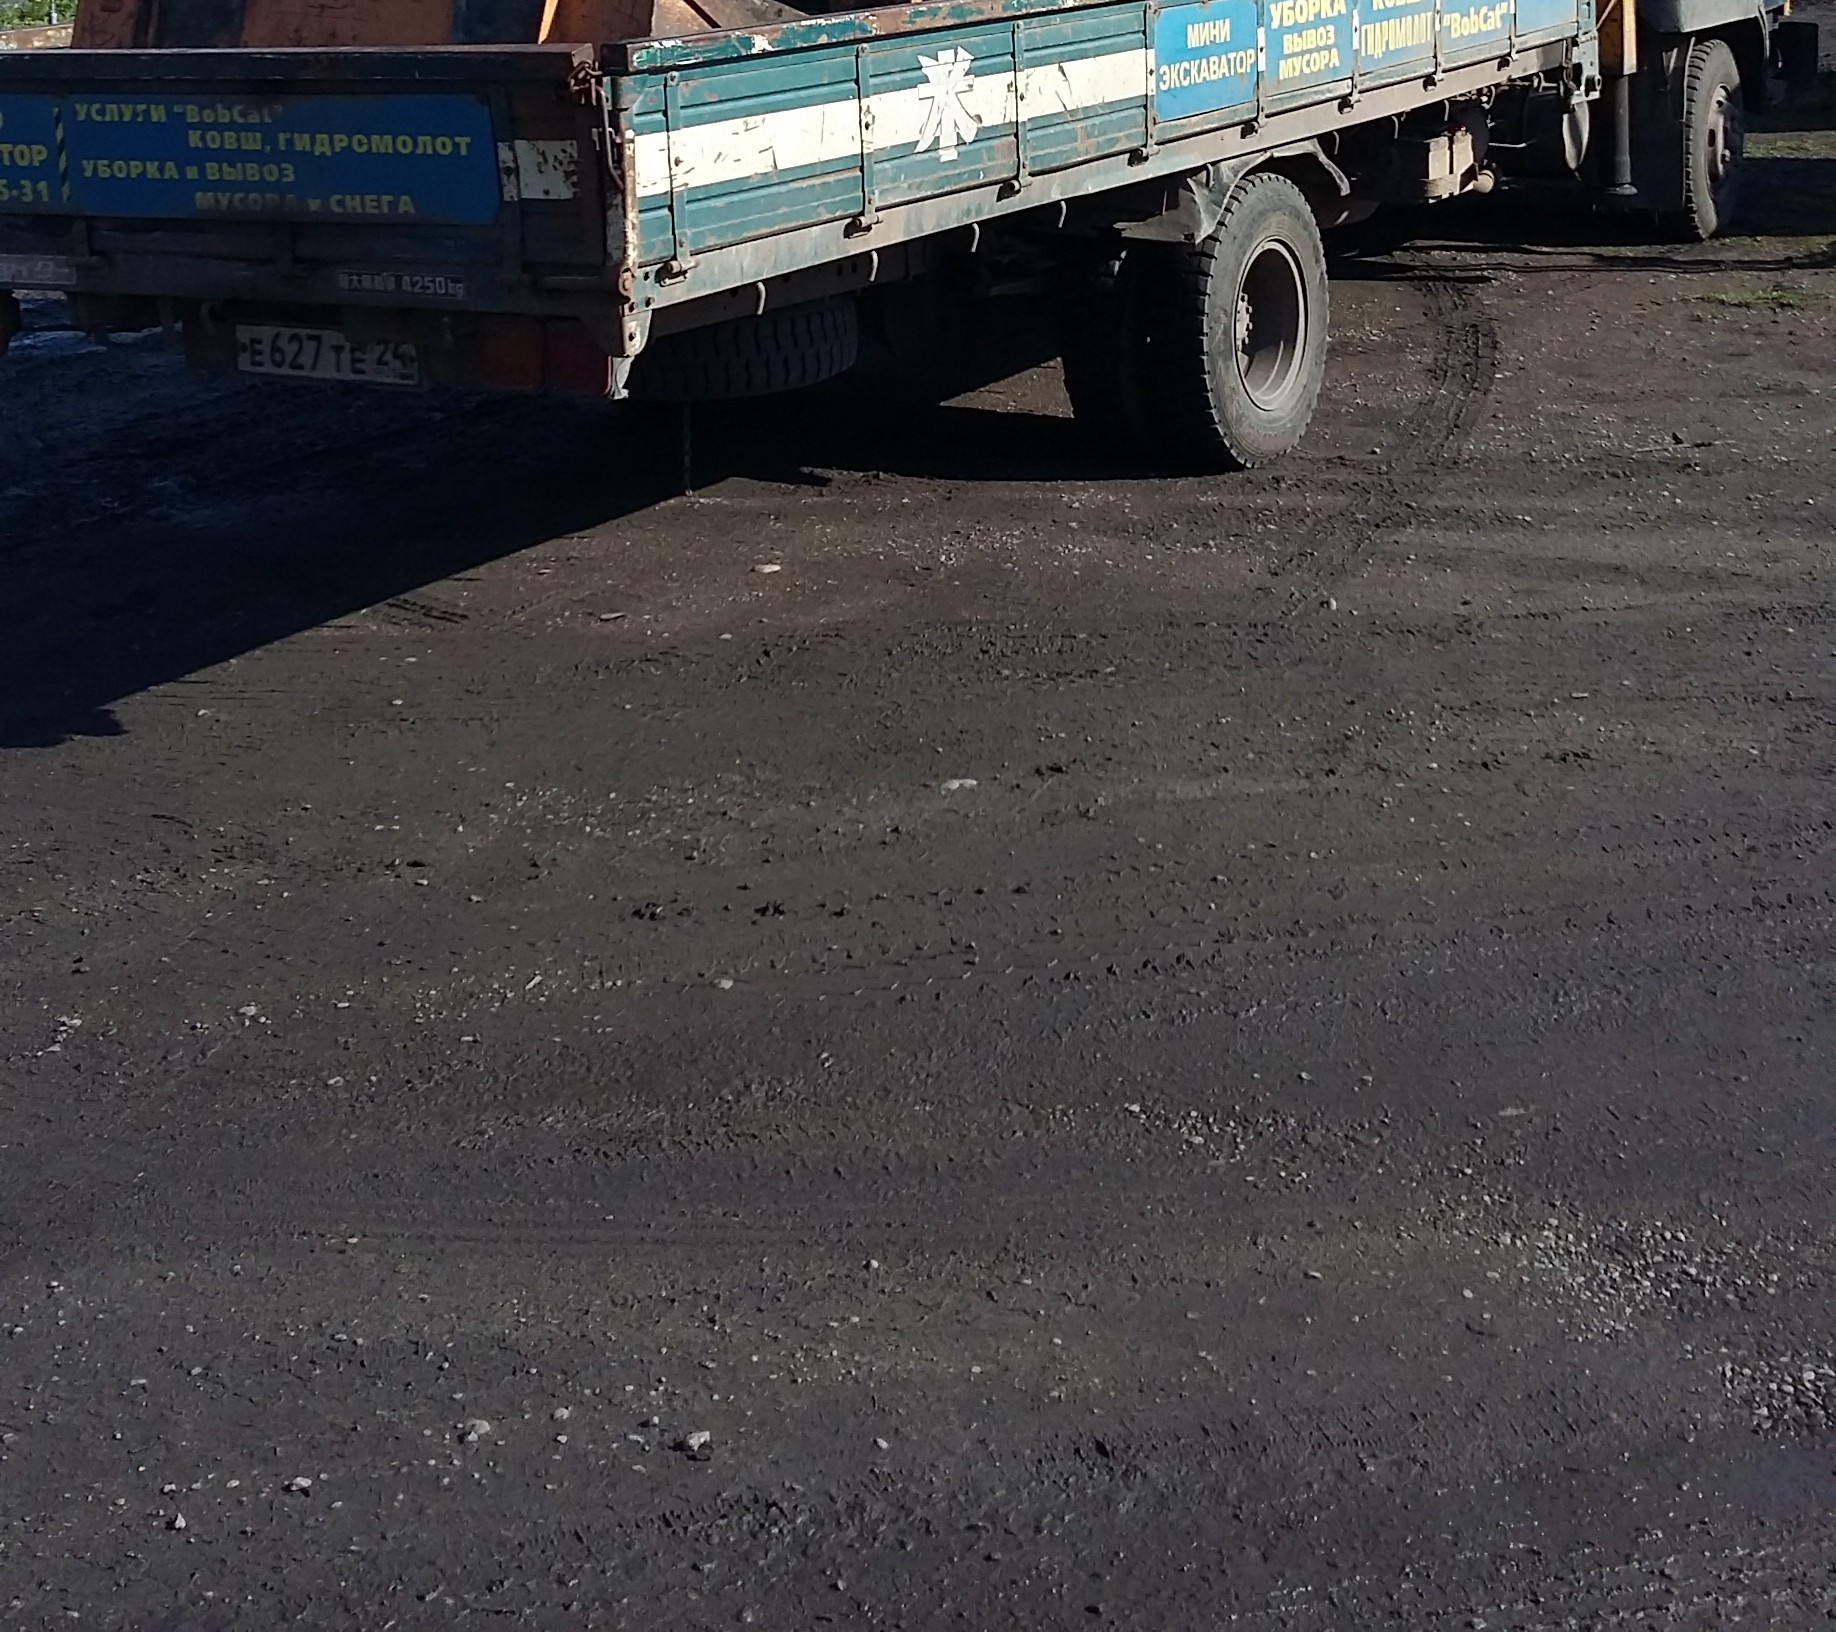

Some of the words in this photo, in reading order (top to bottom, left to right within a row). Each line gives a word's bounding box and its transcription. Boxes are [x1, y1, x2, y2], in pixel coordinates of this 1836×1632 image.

[1186, 18, 1231, 49] МИНИ
[1282, 24, 1336, 55] ВЫВОЗ
[1360, 11, 1433, 59] ГИДРОМОЛОТ
[1158, 48, 1256, 91] ЭКСКАВАТОР
[1278, 47, 1340, 81] МУСОРА
[75, 103, 168, 122] УСЛУГИ
[81, 159, 180, 180] УБОРКА
[204, 162, 296, 182] ВЫВОЗ
[329, 193, 416, 215] СНЕГА
